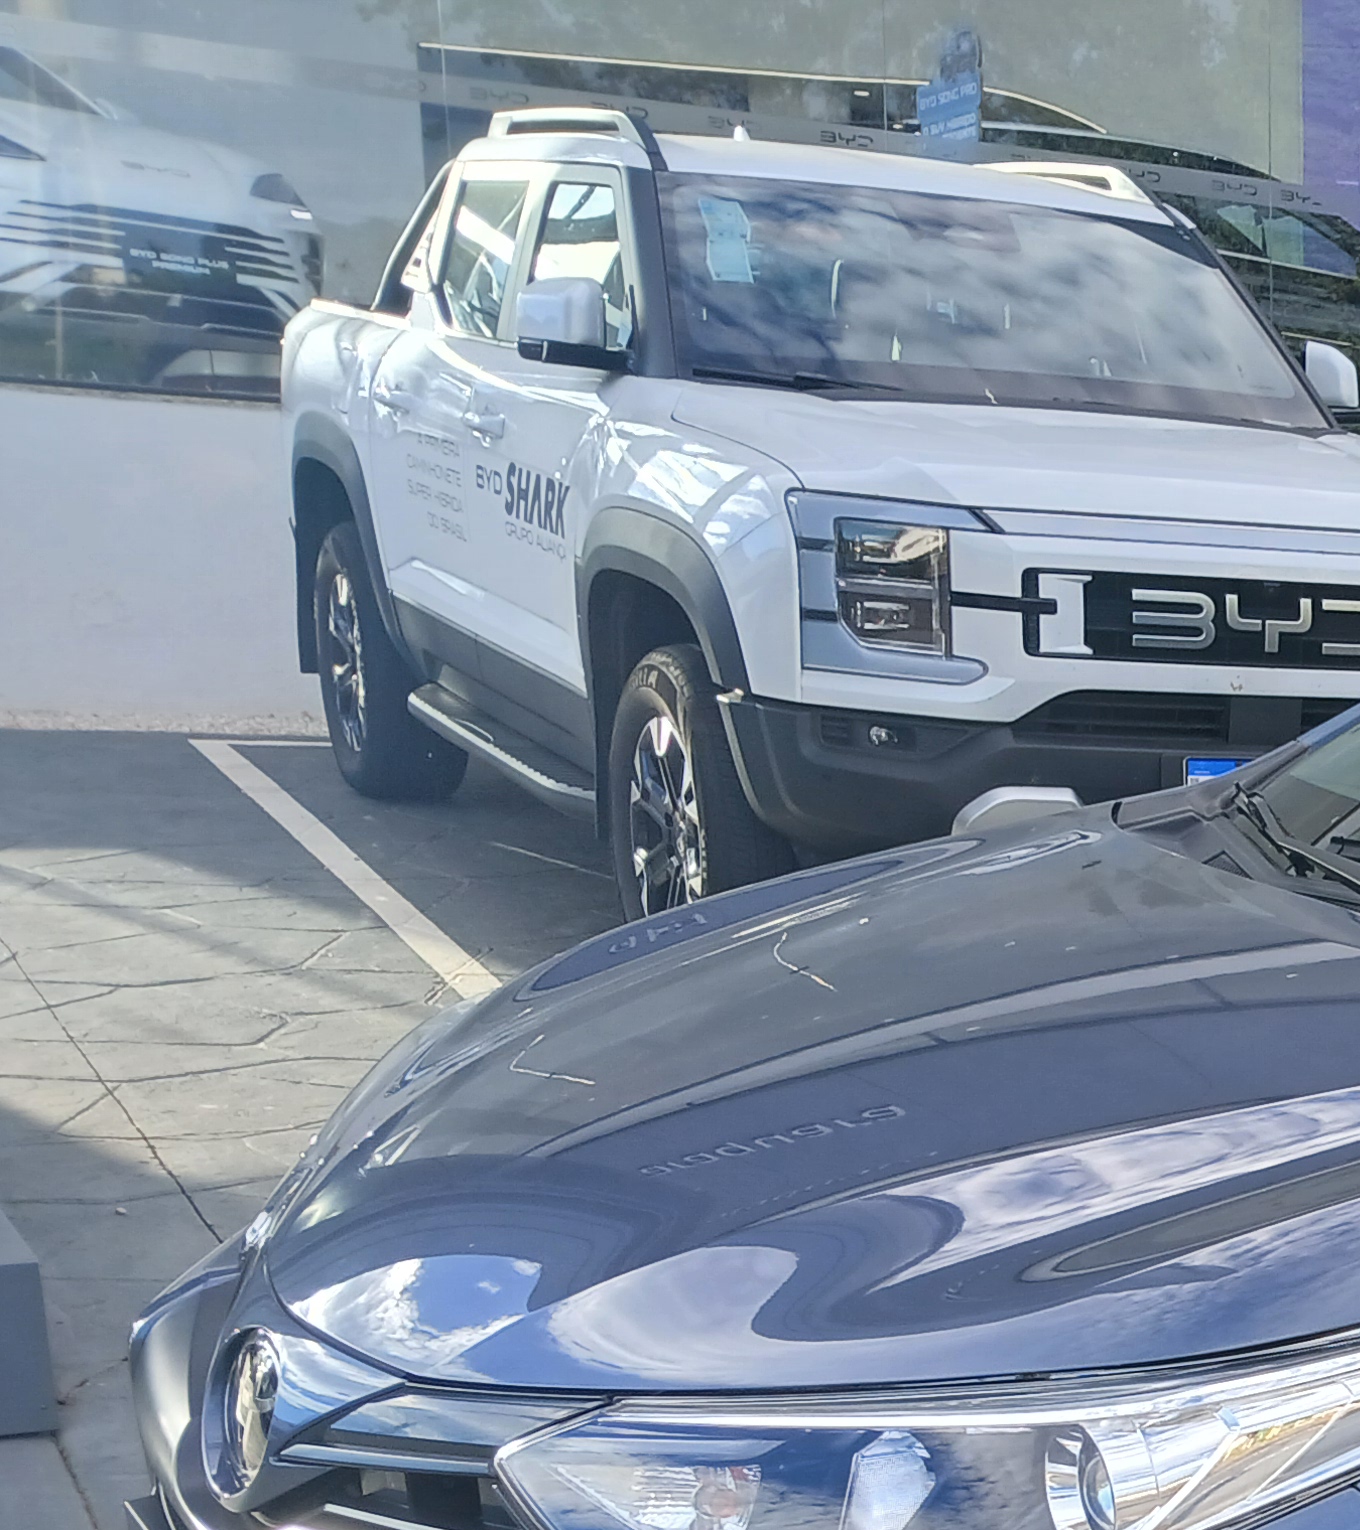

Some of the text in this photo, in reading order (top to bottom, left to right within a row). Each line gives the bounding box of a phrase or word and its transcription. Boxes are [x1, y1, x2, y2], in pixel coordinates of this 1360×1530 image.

[820, 130, 873, 147] BYD
[476, 461, 571, 540] BYD SHARK
